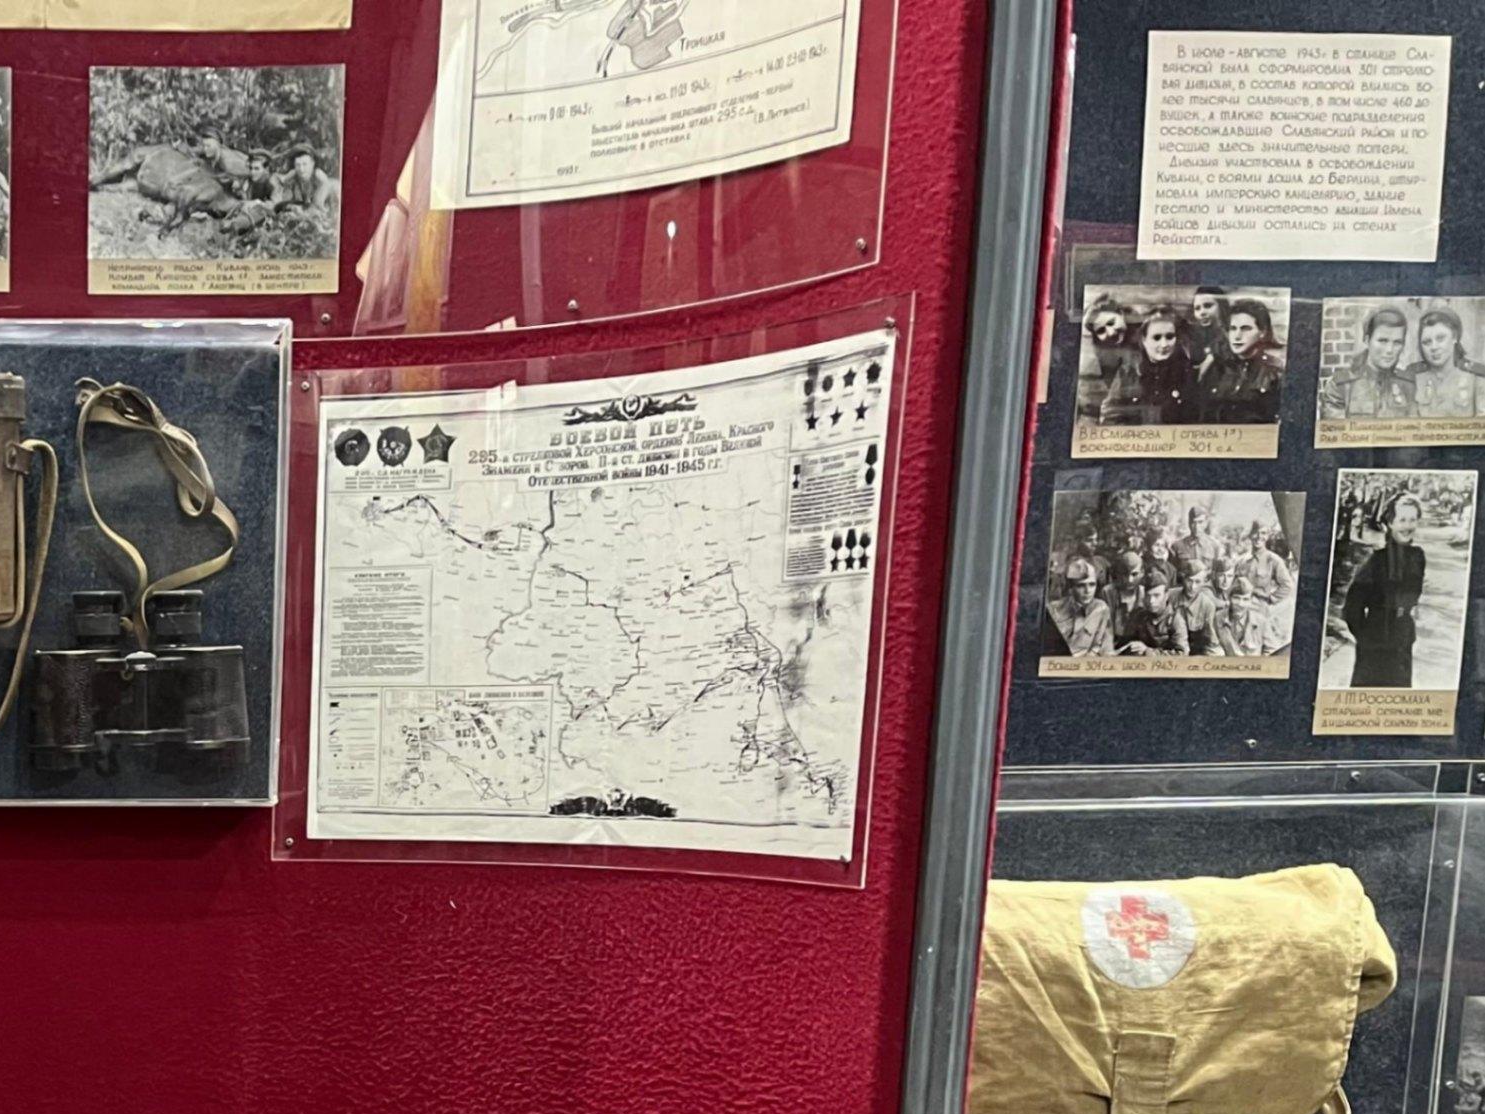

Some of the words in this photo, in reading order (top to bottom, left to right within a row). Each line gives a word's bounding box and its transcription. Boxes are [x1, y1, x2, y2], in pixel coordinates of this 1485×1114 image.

[1220, 63, 1250, 74] была
[1359, 64, 1377, 75] 301
[1251, 80, 1296, 91] состав
[1220, 110, 1264, 121] также
[1218, 142, 1255, 152] здесь
[1218, 173, 1262, 183] боями
[1189, 442, 1212, 453] 301
